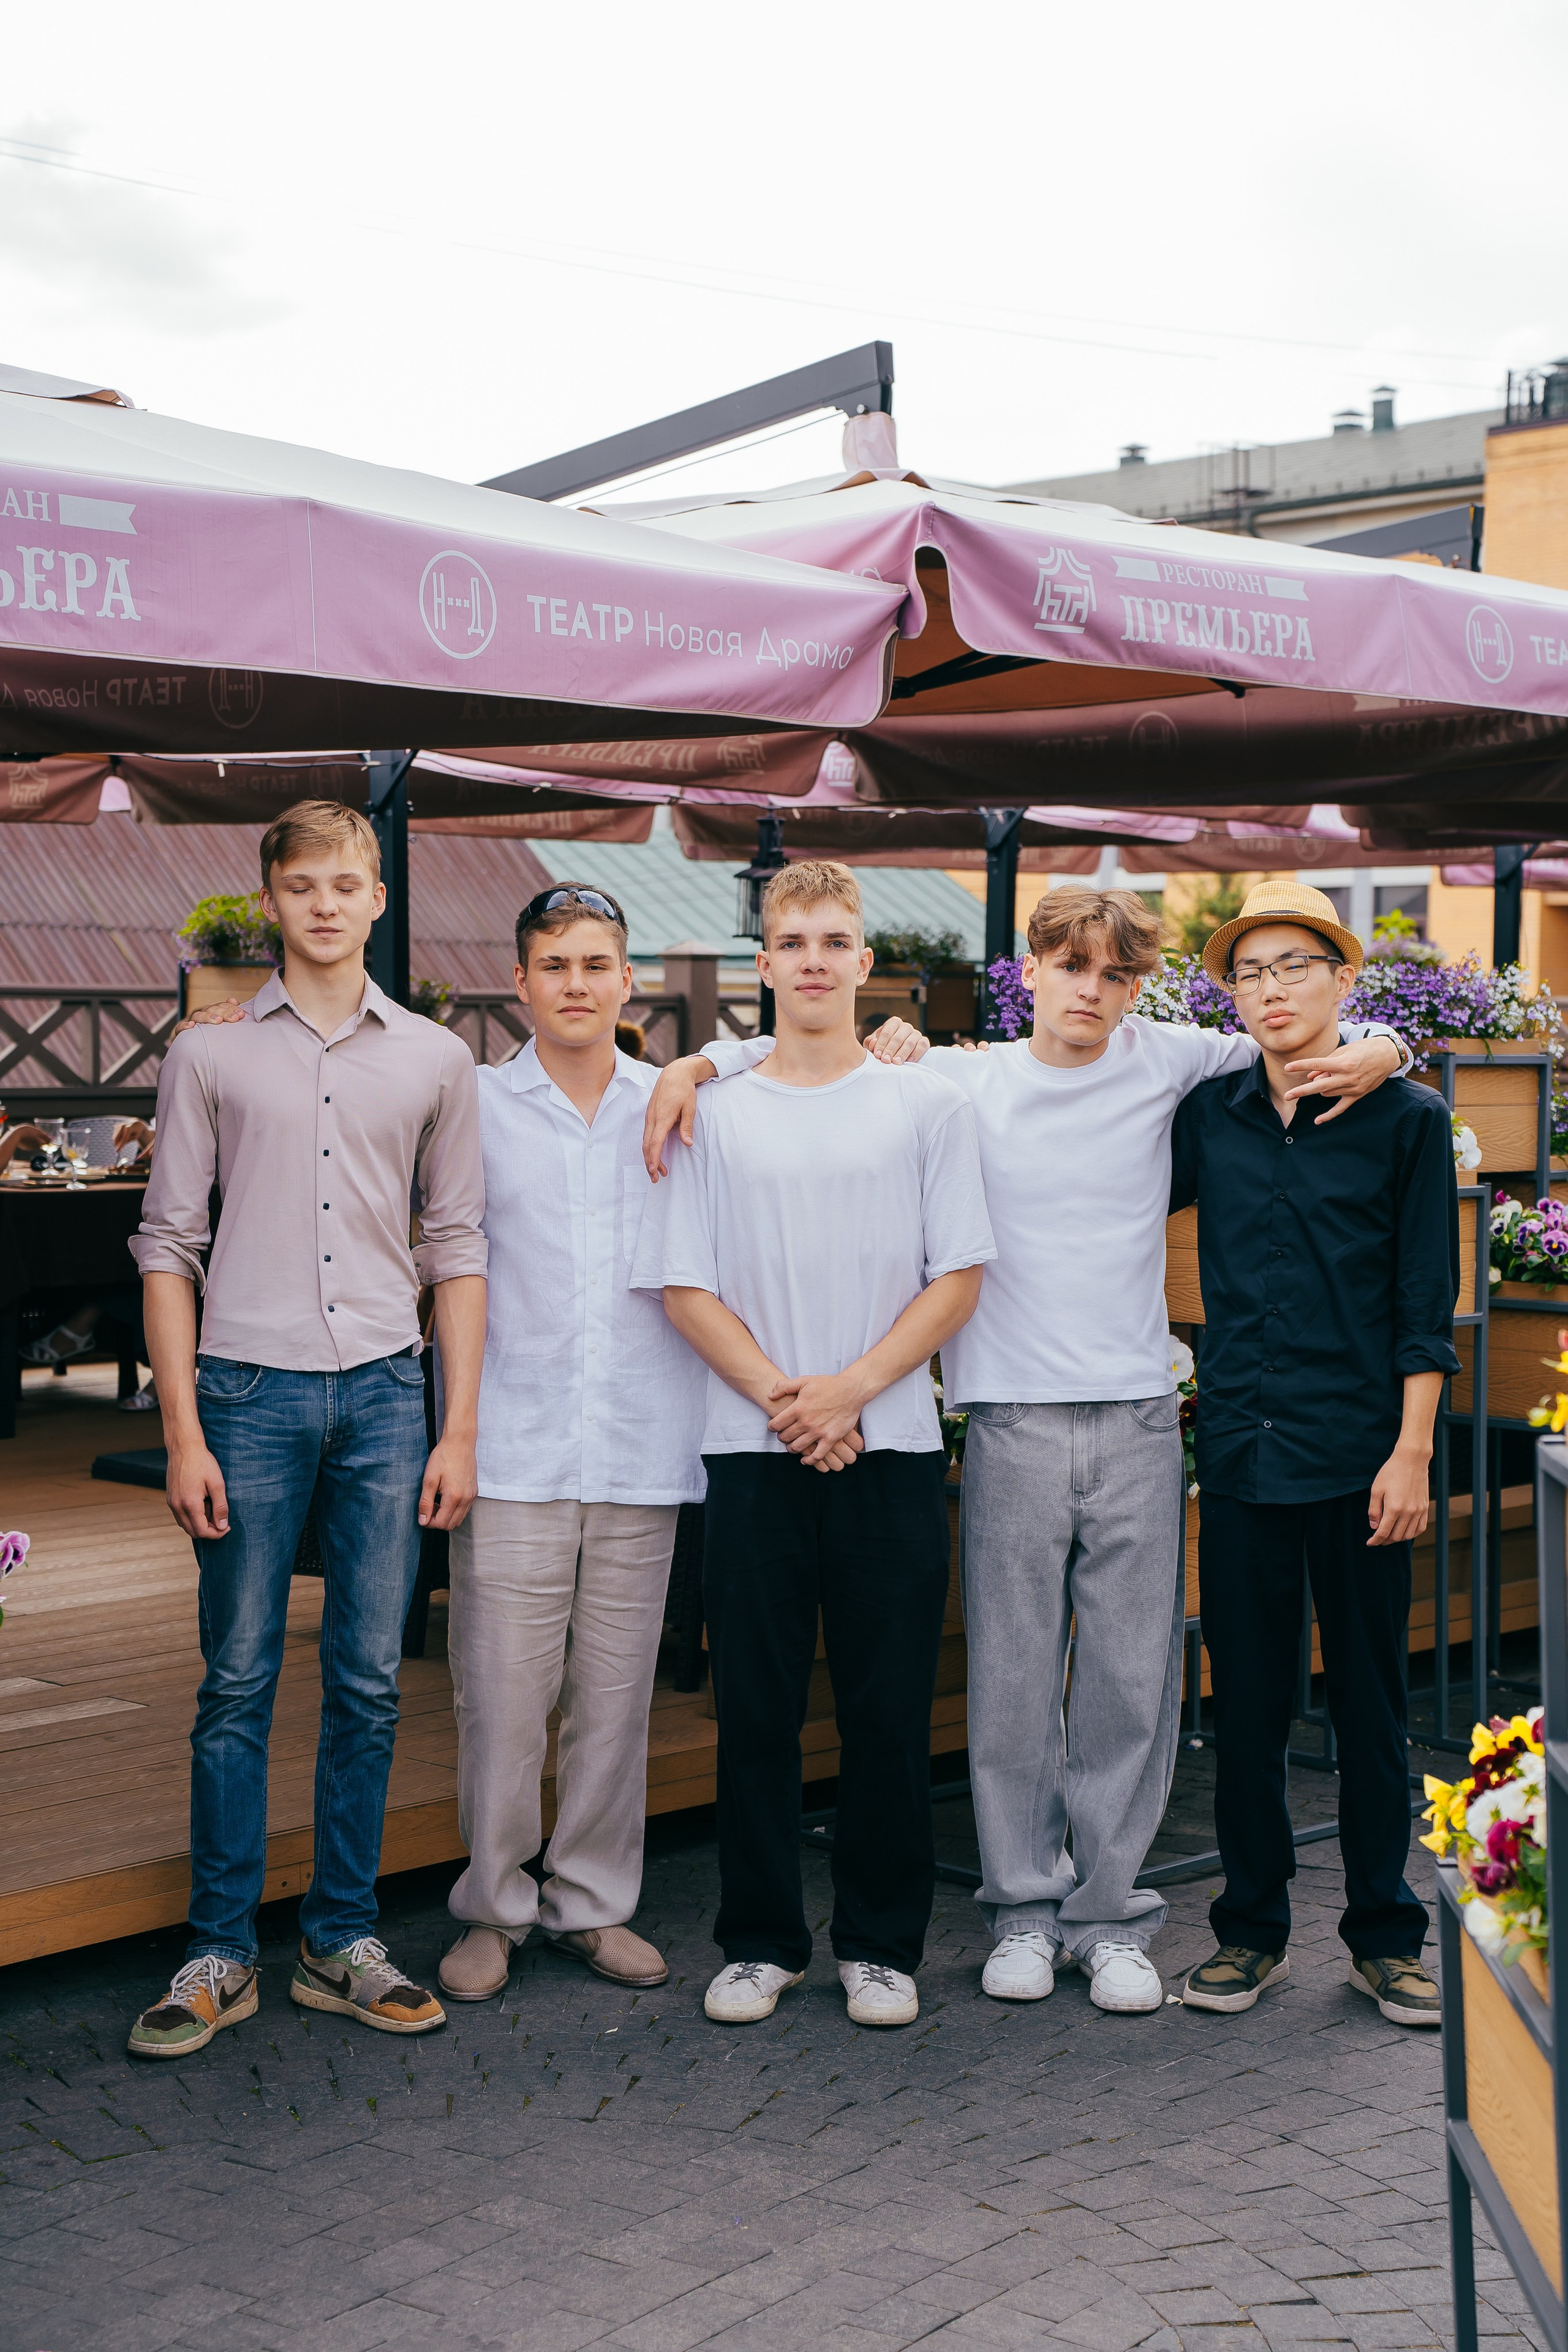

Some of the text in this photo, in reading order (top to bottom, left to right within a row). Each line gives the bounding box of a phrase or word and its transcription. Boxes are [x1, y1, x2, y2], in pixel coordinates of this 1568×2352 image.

[1161, 562, 1265, 595] РЕСТОРАН
[526, 594, 854, 671] ТЕАТР Новая Драма
[1119, 594, 1316, 662] ПРЕМЬЕРА
